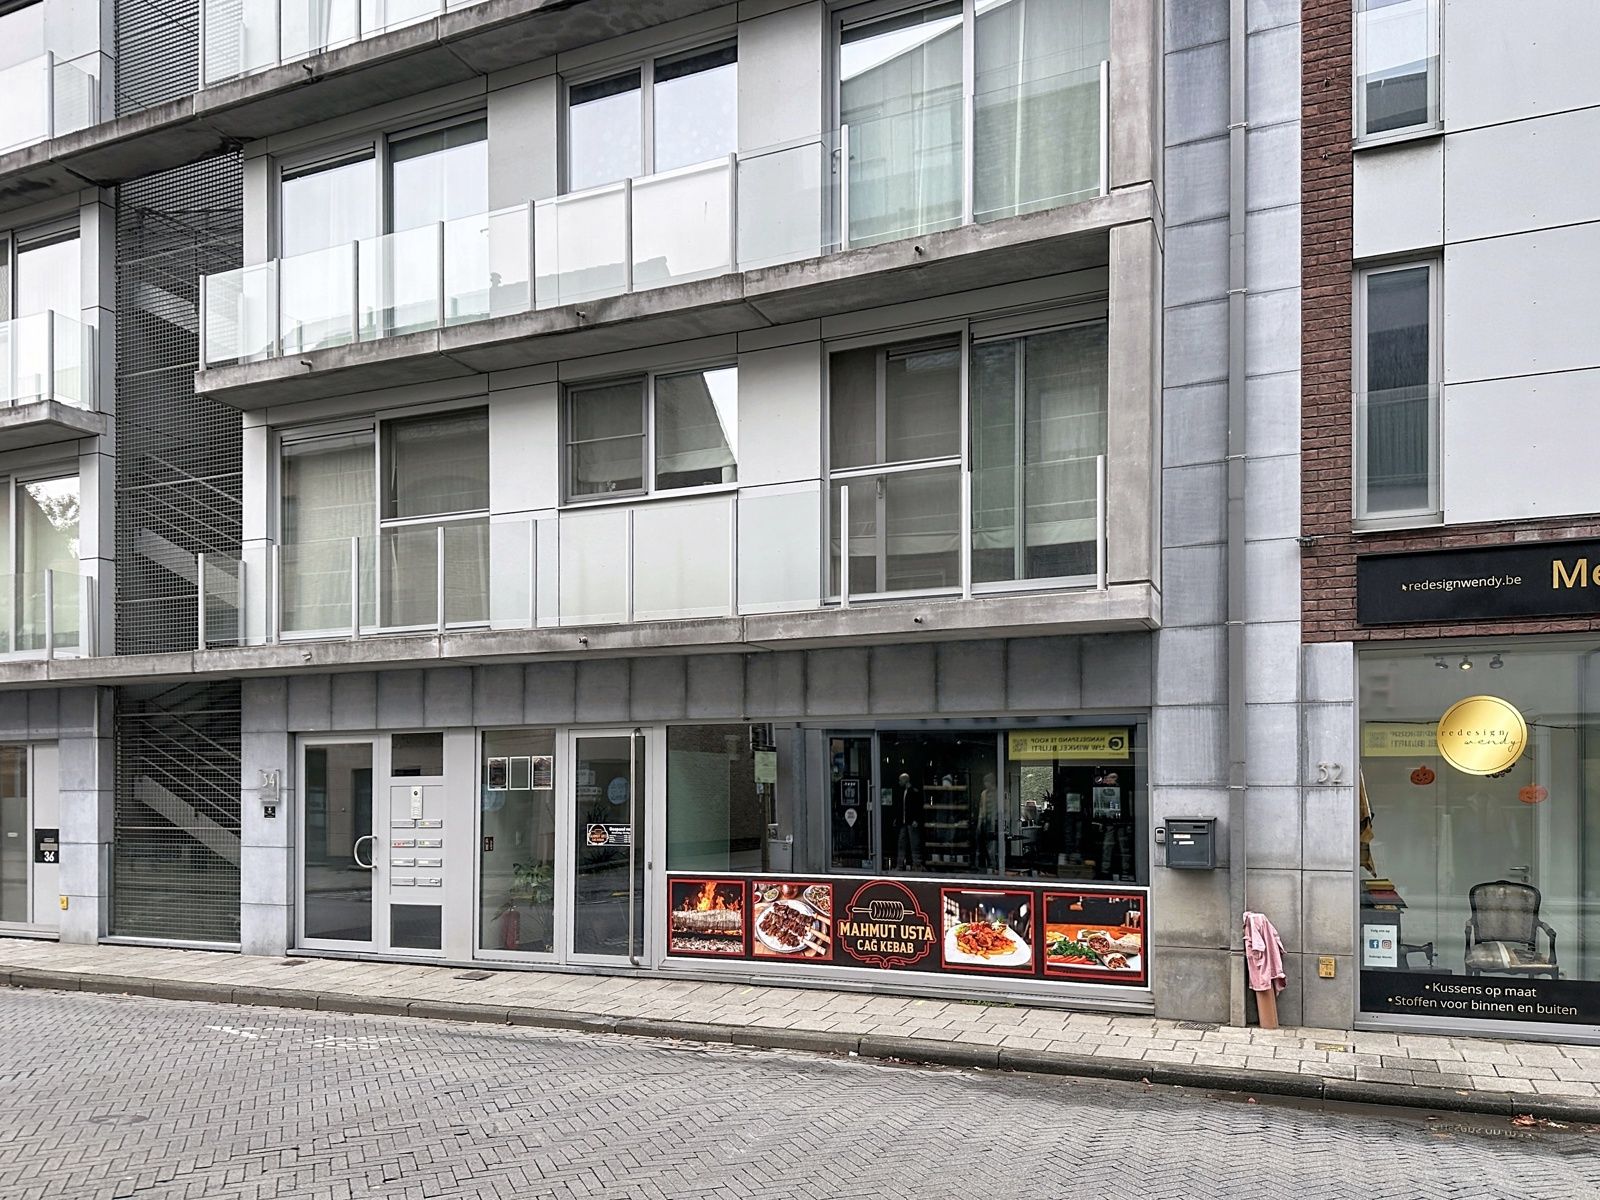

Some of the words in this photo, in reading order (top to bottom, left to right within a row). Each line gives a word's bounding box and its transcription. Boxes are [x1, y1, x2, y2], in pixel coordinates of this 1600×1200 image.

[1409, 575, 1522, 592] redesignwendy.be
[1441, 728, 1505, 737] redesign
[1464, 731, 1520, 753] wendy
[262, 773, 275, 787] 34
[44, 851, 55, 862] 36
[840, 922, 897, 938] MAHMUT
[900, 925, 933, 940] USTA
[857, 939, 877, 951] CAĞ
[880, 941, 914, 953] KEBAB
[1432, 983, 1482, 995] Kussens
[1485, 987, 1502, 998] op
[1505, 987, 1537, 998] maat
[1395, 995, 1437, 1008] Stoffen
[1440, 1000, 1468, 1010] voor
[1471, 1000, 1514, 1012] binnen
[1518, 1004, 1533, 1013] en
[1537, 1003, 1577, 1016] buiten
